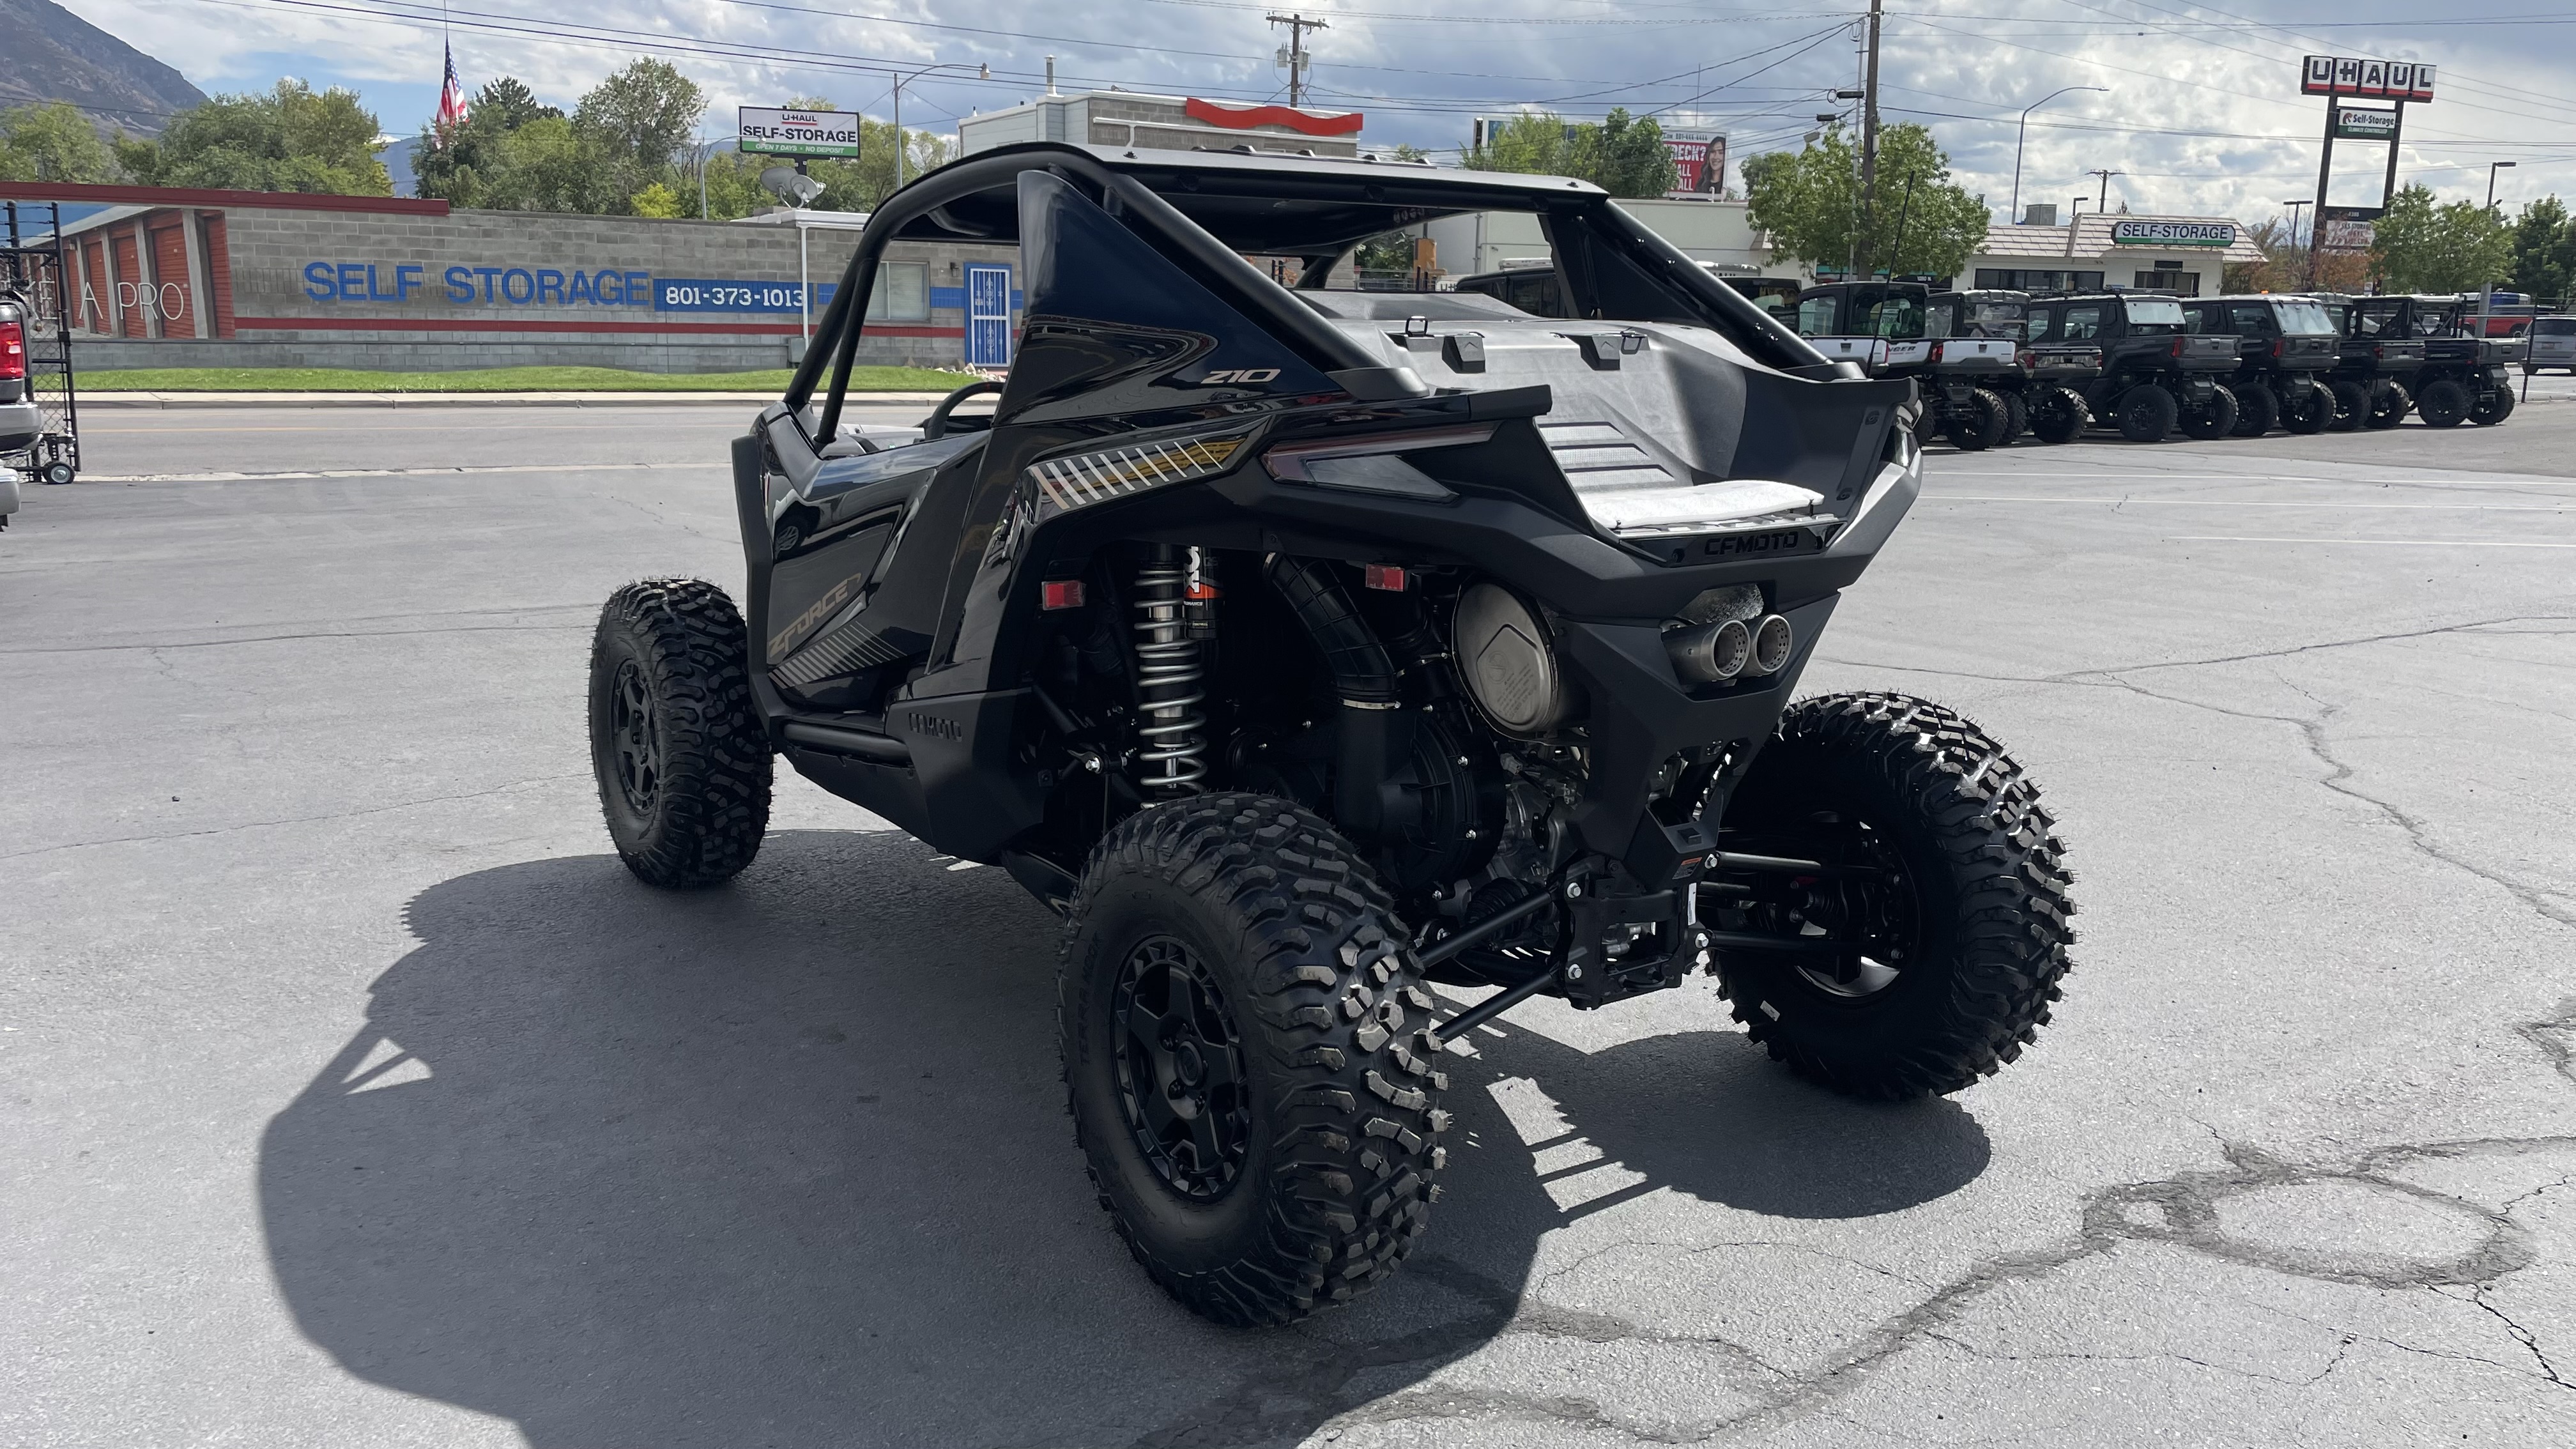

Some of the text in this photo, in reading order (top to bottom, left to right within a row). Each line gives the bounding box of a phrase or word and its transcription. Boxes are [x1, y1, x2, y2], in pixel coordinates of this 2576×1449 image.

[743, 125, 857, 142] SELF-STORAGE
[1663, 144, 1706, 161] RECK?
[1677, 164, 1692, 176] ALL
[2122, 224, 2228, 240] SELF-STORAGE
[303, 261, 650, 306] SELF STORAGE
[79, 282, 103, 319] A
[118, 282, 184, 320] PRO
[666, 286, 803, 307] 801-373-1013
[1704, 531, 1799, 555] CFMOTO
[908, 712, 962, 742] CFMOTO
